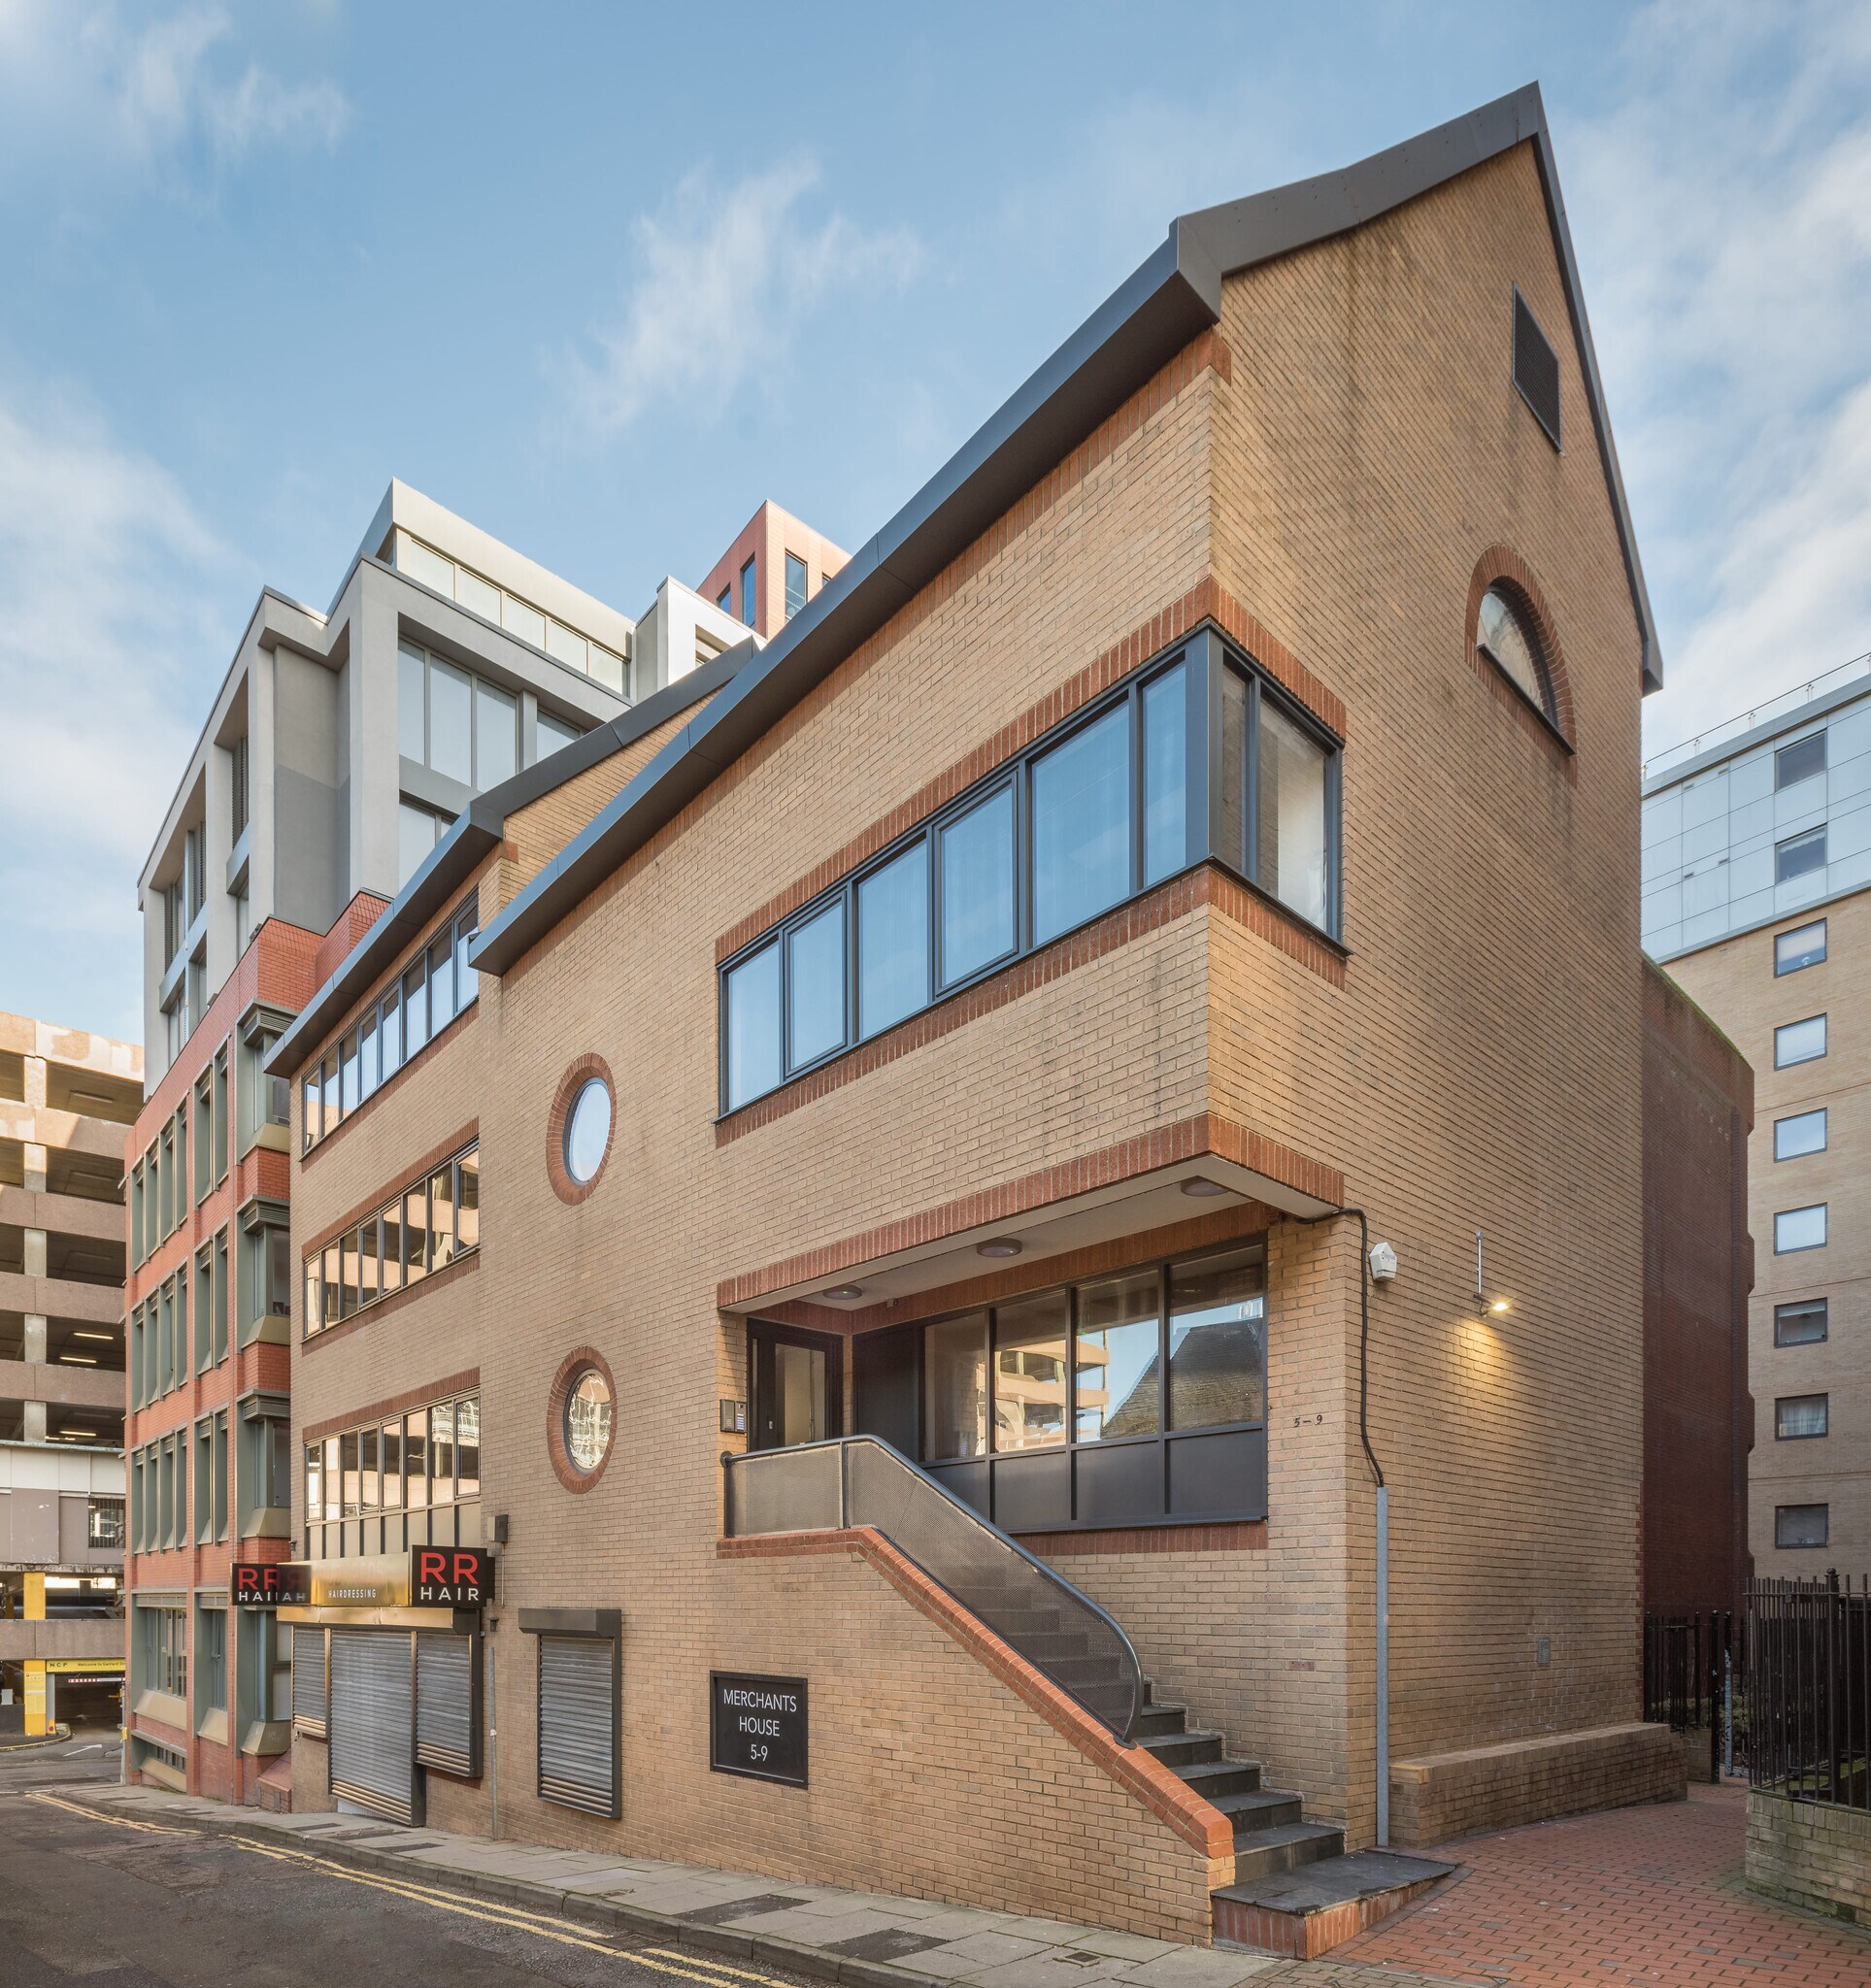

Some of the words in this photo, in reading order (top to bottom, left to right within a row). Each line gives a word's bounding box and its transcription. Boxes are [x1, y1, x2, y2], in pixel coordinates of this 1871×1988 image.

[420, 1552, 480, 1585] RR
[327, 1588, 377, 1599] HAIRDRESSING
[420, 1586, 480, 1602] HAIR
[723, 1689, 797, 1712] MERCHANTS
[739, 1716, 780, 1737] HOUSE
[751, 1743, 768, 1762] 5-9
